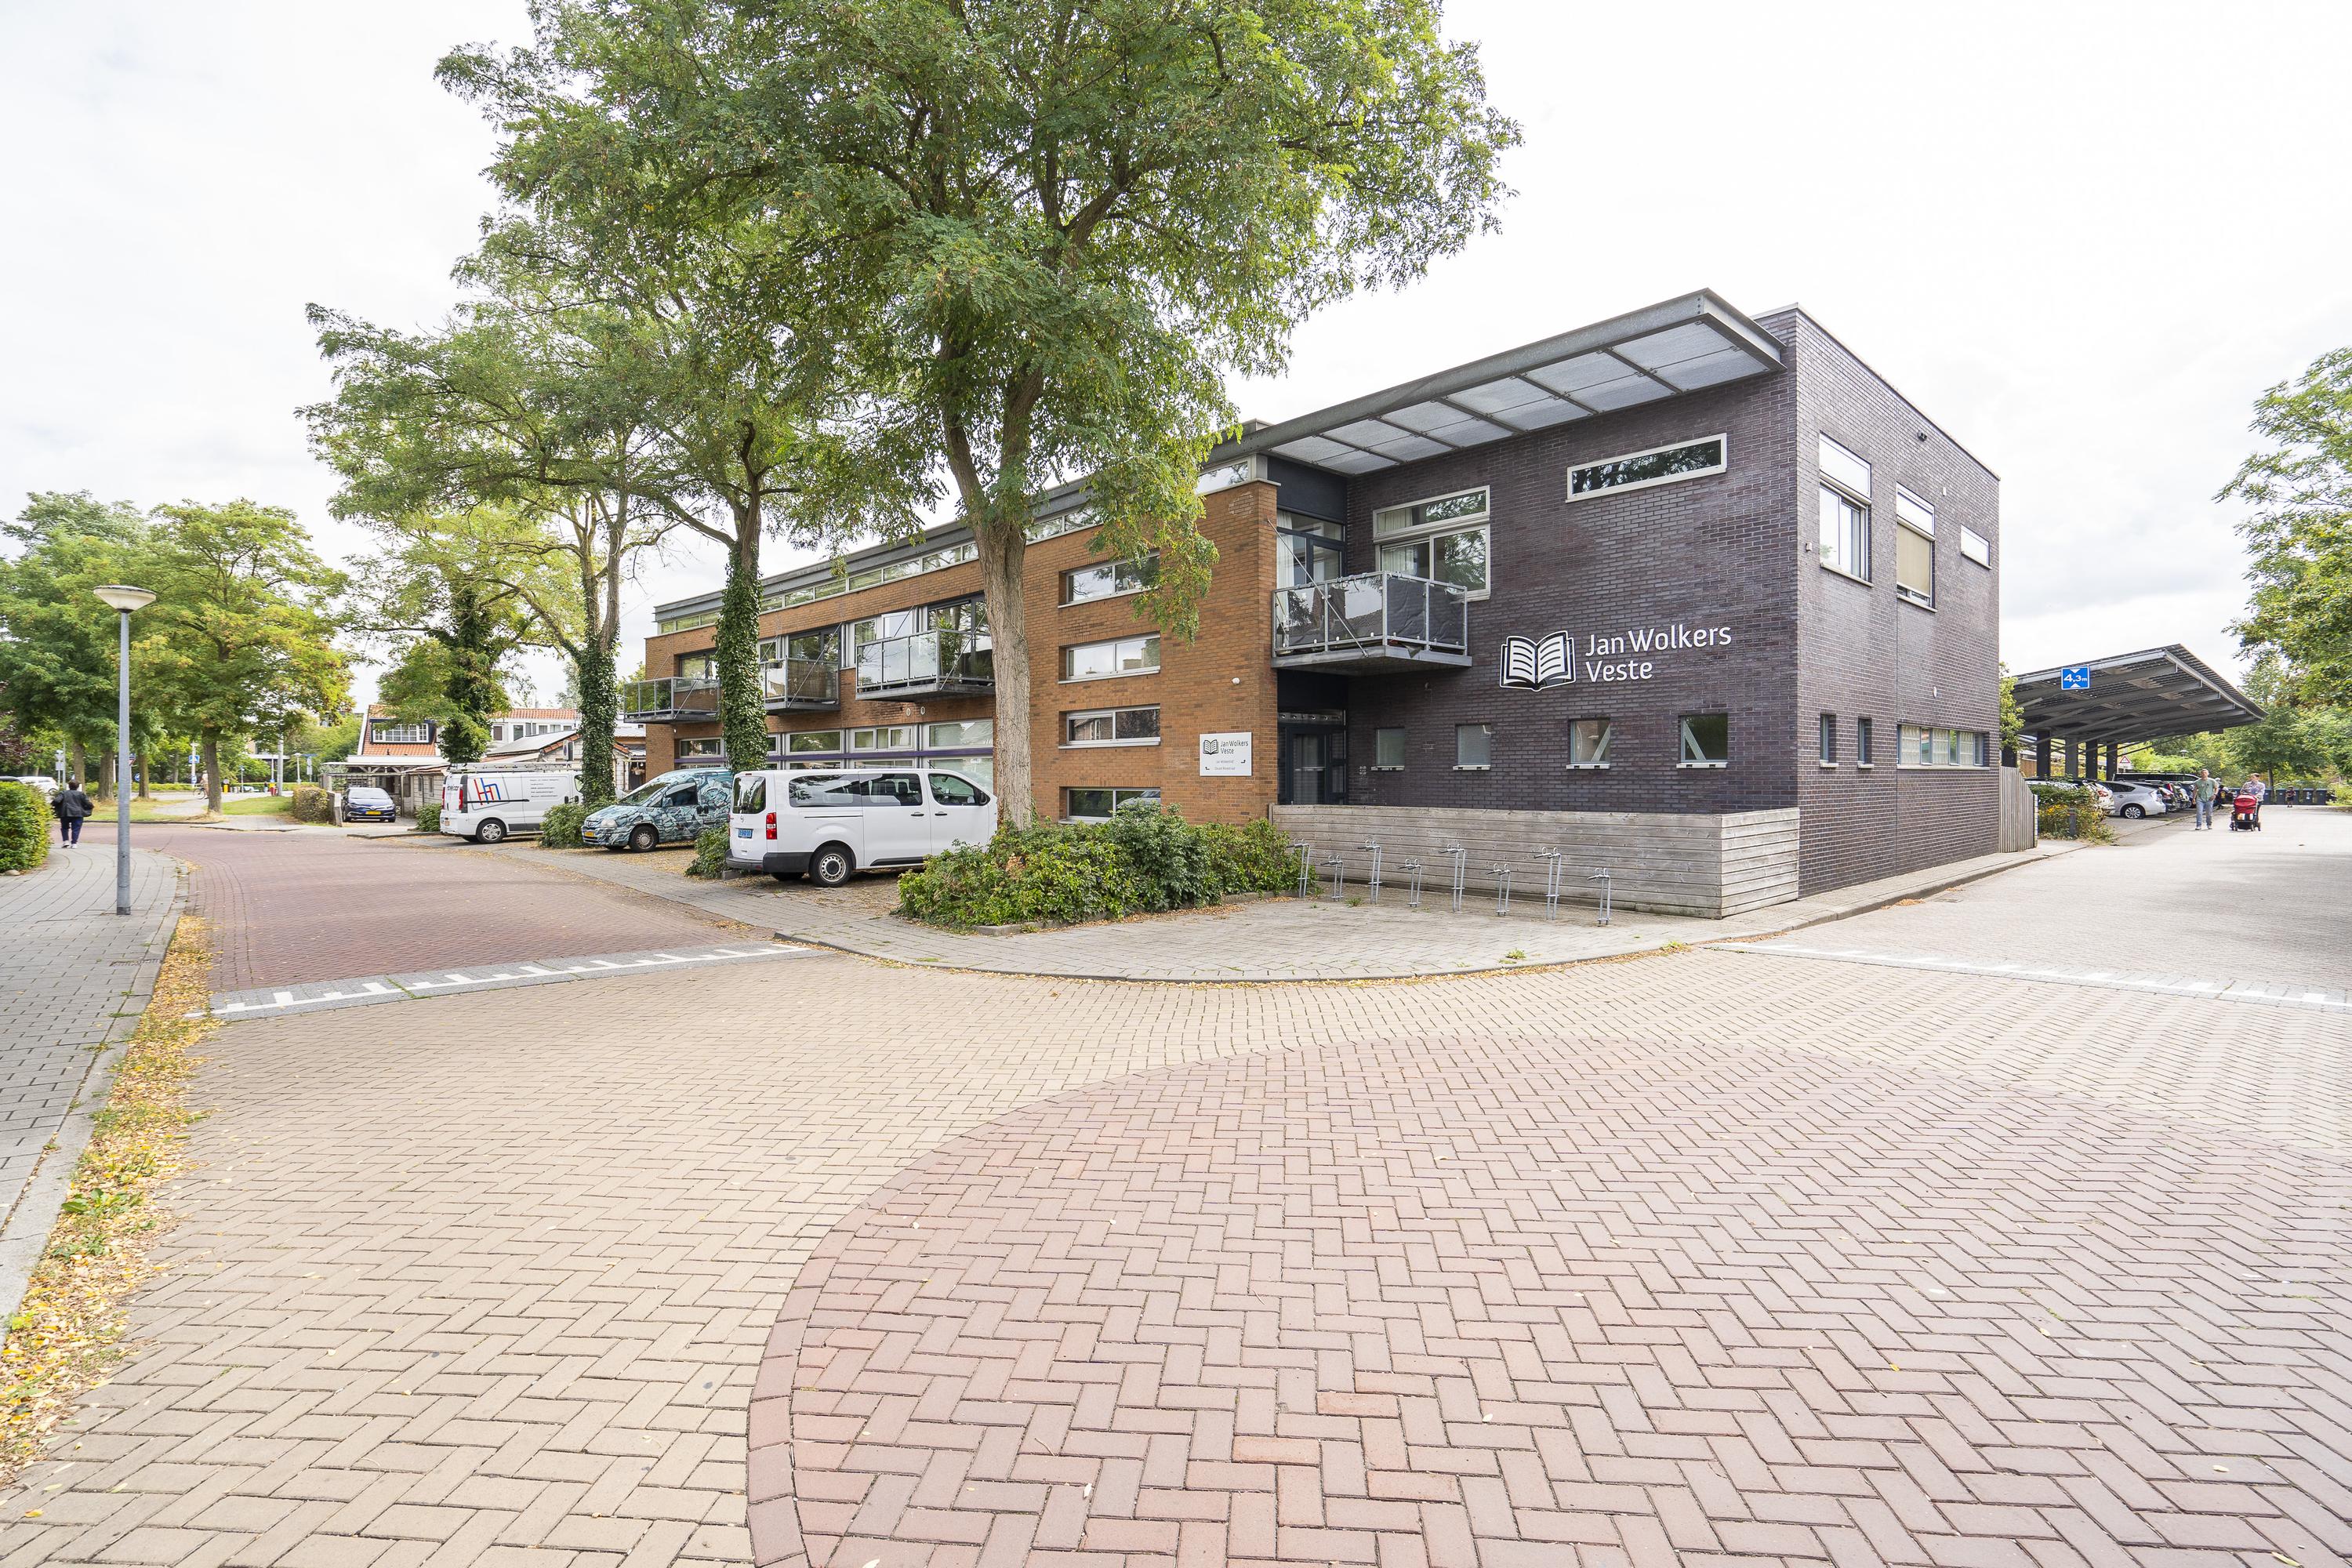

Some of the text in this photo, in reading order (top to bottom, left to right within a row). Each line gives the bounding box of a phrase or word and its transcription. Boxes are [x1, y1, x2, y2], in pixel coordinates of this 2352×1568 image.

[1585, 624, 1732, 657] Jan Wolkers
[1585, 659, 1653, 683] Veste
